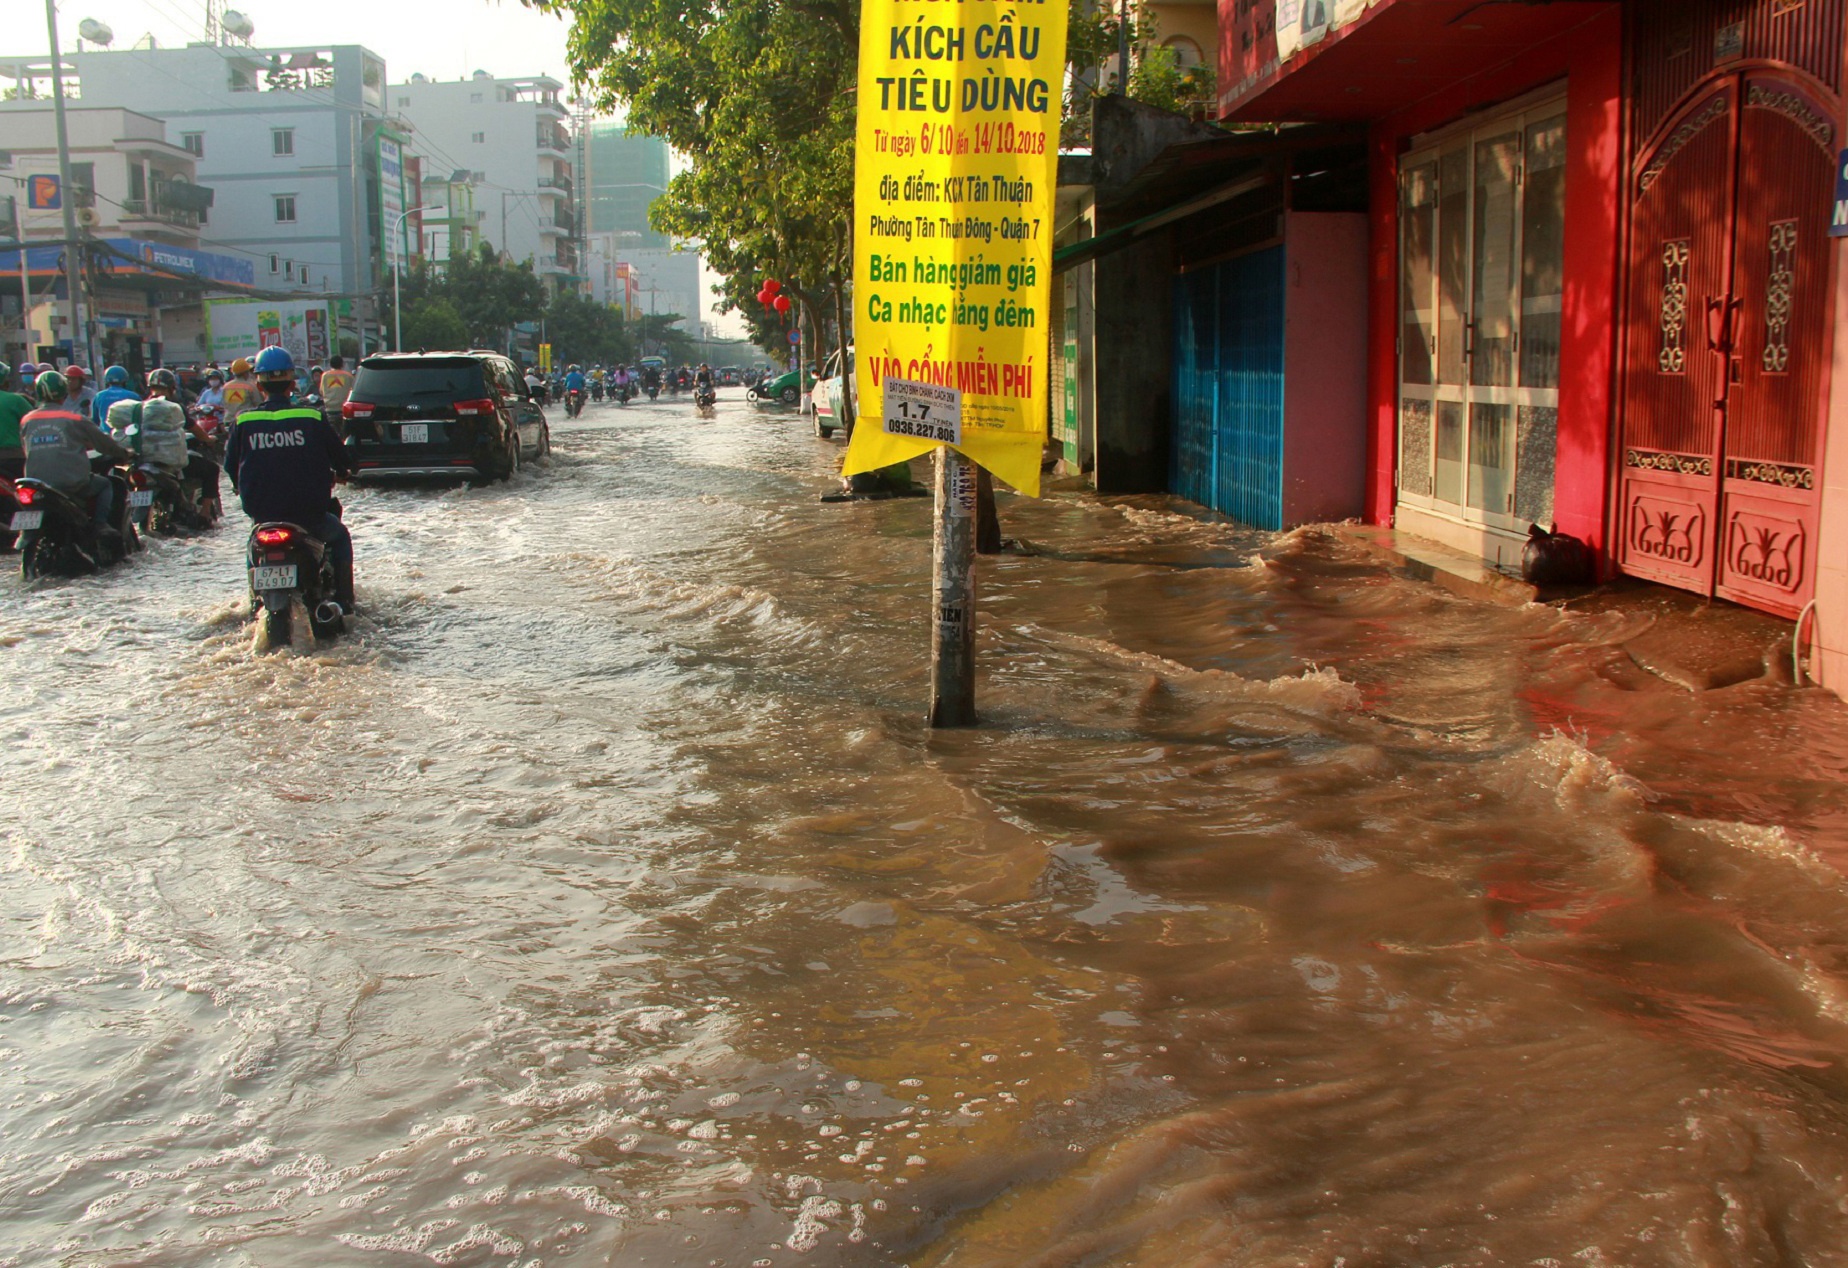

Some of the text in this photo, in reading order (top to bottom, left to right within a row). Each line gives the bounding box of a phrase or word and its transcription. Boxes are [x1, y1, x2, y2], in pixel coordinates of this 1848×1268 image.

[890, 10, 1040, 61] KÍCH CẦU
[876, 68, 1049, 114] TIÊU DÙNG
[874, 129, 889, 153] Từ
[891, 130, 916, 157] ngày
[956, 129, 969, 154] đến
[974, 121, 1046, 155] 14/10.2018
[879, 169, 1033, 207] địa điểm: KCX Tân Thuận
[870, 215, 912, 242] Phường
[915, 216, 936, 238] Tân
[965, 216, 991, 243] Đông
[1000, 216, 1030, 243] Quận
[1032, 218, 1041, 240] 7
[869, 253, 1036, 291] Bán hàng giảm giá
[869, 294, 893, 322] Ca
[899, 297, 947, 332] nhạc
[994, 298, 1035, 328] đêm
[957, 346, 999, 395] MIỄN
[1003, 355, 1033, 399] PHÍ
[898, 402, 930, 420] 1.7
[249, 430, 305, 450] VICONS
[408, 426, 421, 434] 51F
[889, 419, 955, 443] 0936.227.806
[257, 576, 294, 588] 649.07
[262, 567, 290, 578] 67-L1
